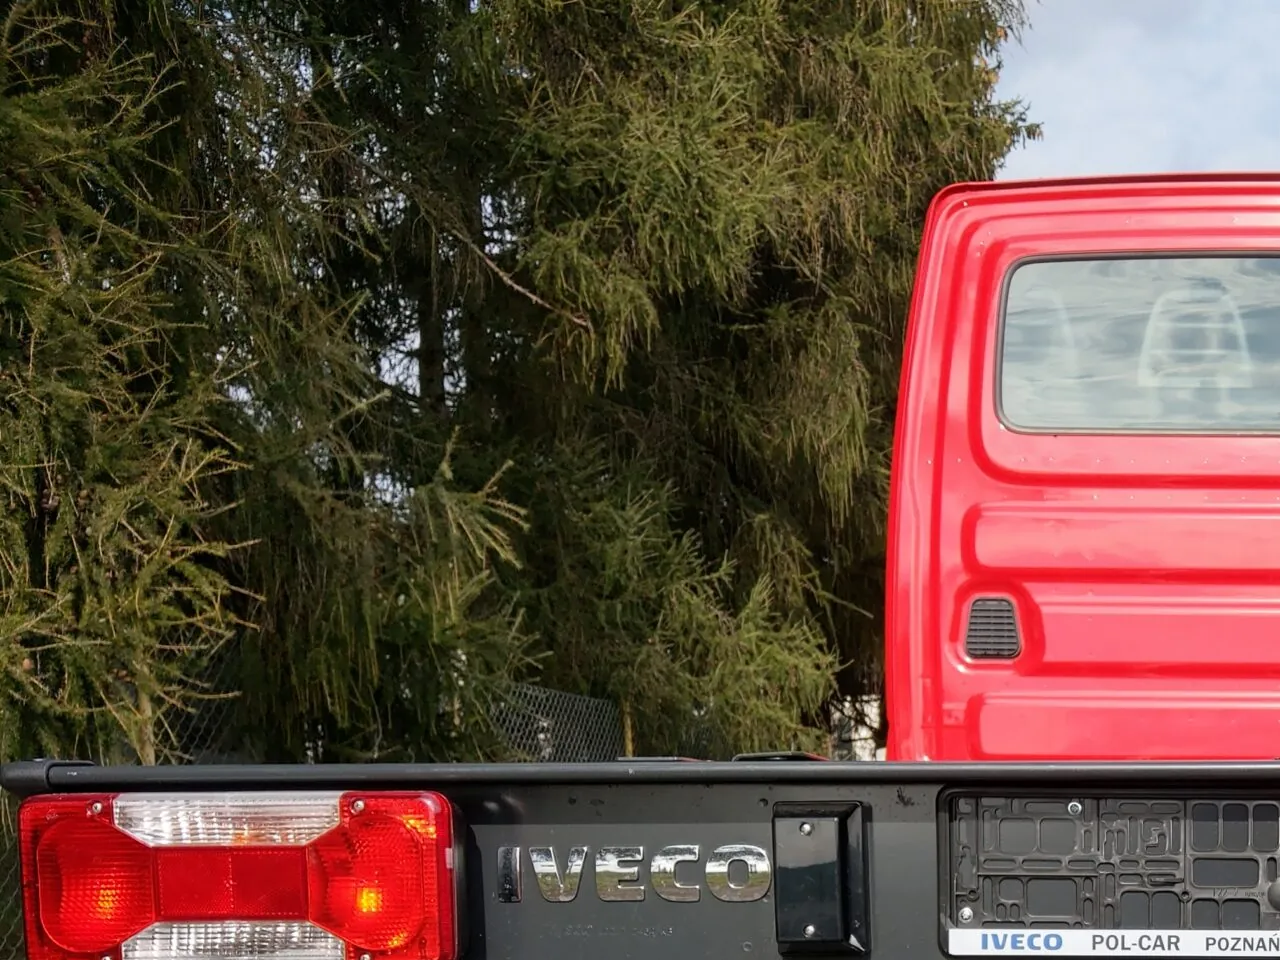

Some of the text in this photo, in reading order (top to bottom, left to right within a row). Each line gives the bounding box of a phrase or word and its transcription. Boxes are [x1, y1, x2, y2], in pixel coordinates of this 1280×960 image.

[498, 845, 772, 903] IVECO
[981, 933, 1063, 950] IVECO
[1092, 935, 1181, 951] POL-CAR
